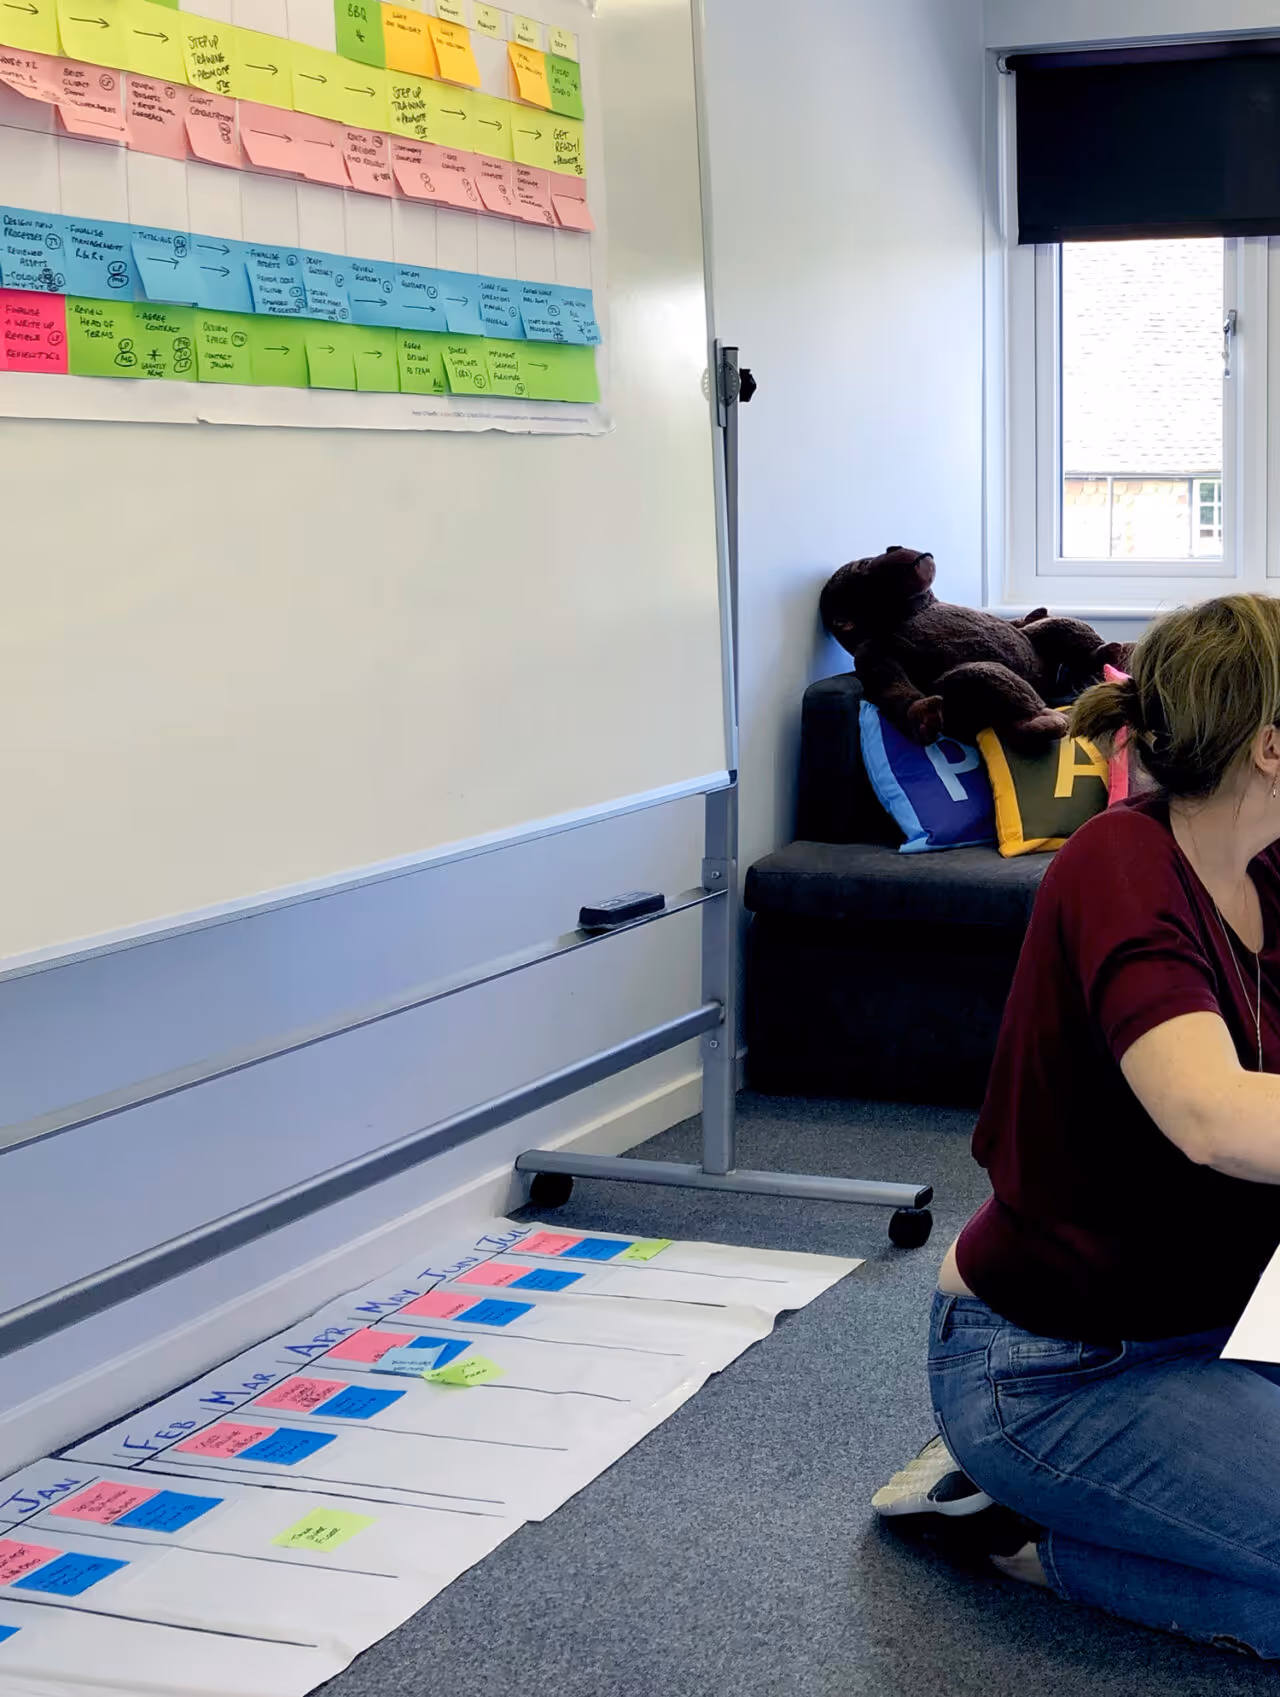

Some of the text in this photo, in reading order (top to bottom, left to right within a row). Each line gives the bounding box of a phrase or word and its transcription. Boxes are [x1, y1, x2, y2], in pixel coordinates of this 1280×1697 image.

[348, 3, 368, 23] BBQ
[188, 35, 219, 50] STEP UP
[392, 86, 422, 100] STEP UP
[553, 128, 570, 140] GET
[3, 214, 33, 227] DESIGN
[74, 304, 104, 316] REVIEW
[142, 312, 167, 324] AGREE
[103, 319, 115, 329] OF
[145, 323, 181, 334] CONTRACT
[84, 329, 115, 340] TERMS
[925, 734, 980, 802] P
[1054, 732, 1109, 798] A
[475, 1227, 532, 1252] JUL
[417, 1255, 480, 1281] JUN
[355, 1288, 421, 1315] MAY
[284, 1326, 354, 1358] APR
[198, 1372, 277, 1406] MAR
[122, 1420, 196, 1451] FEB
[0, 1477, 81, 1514] JAN
